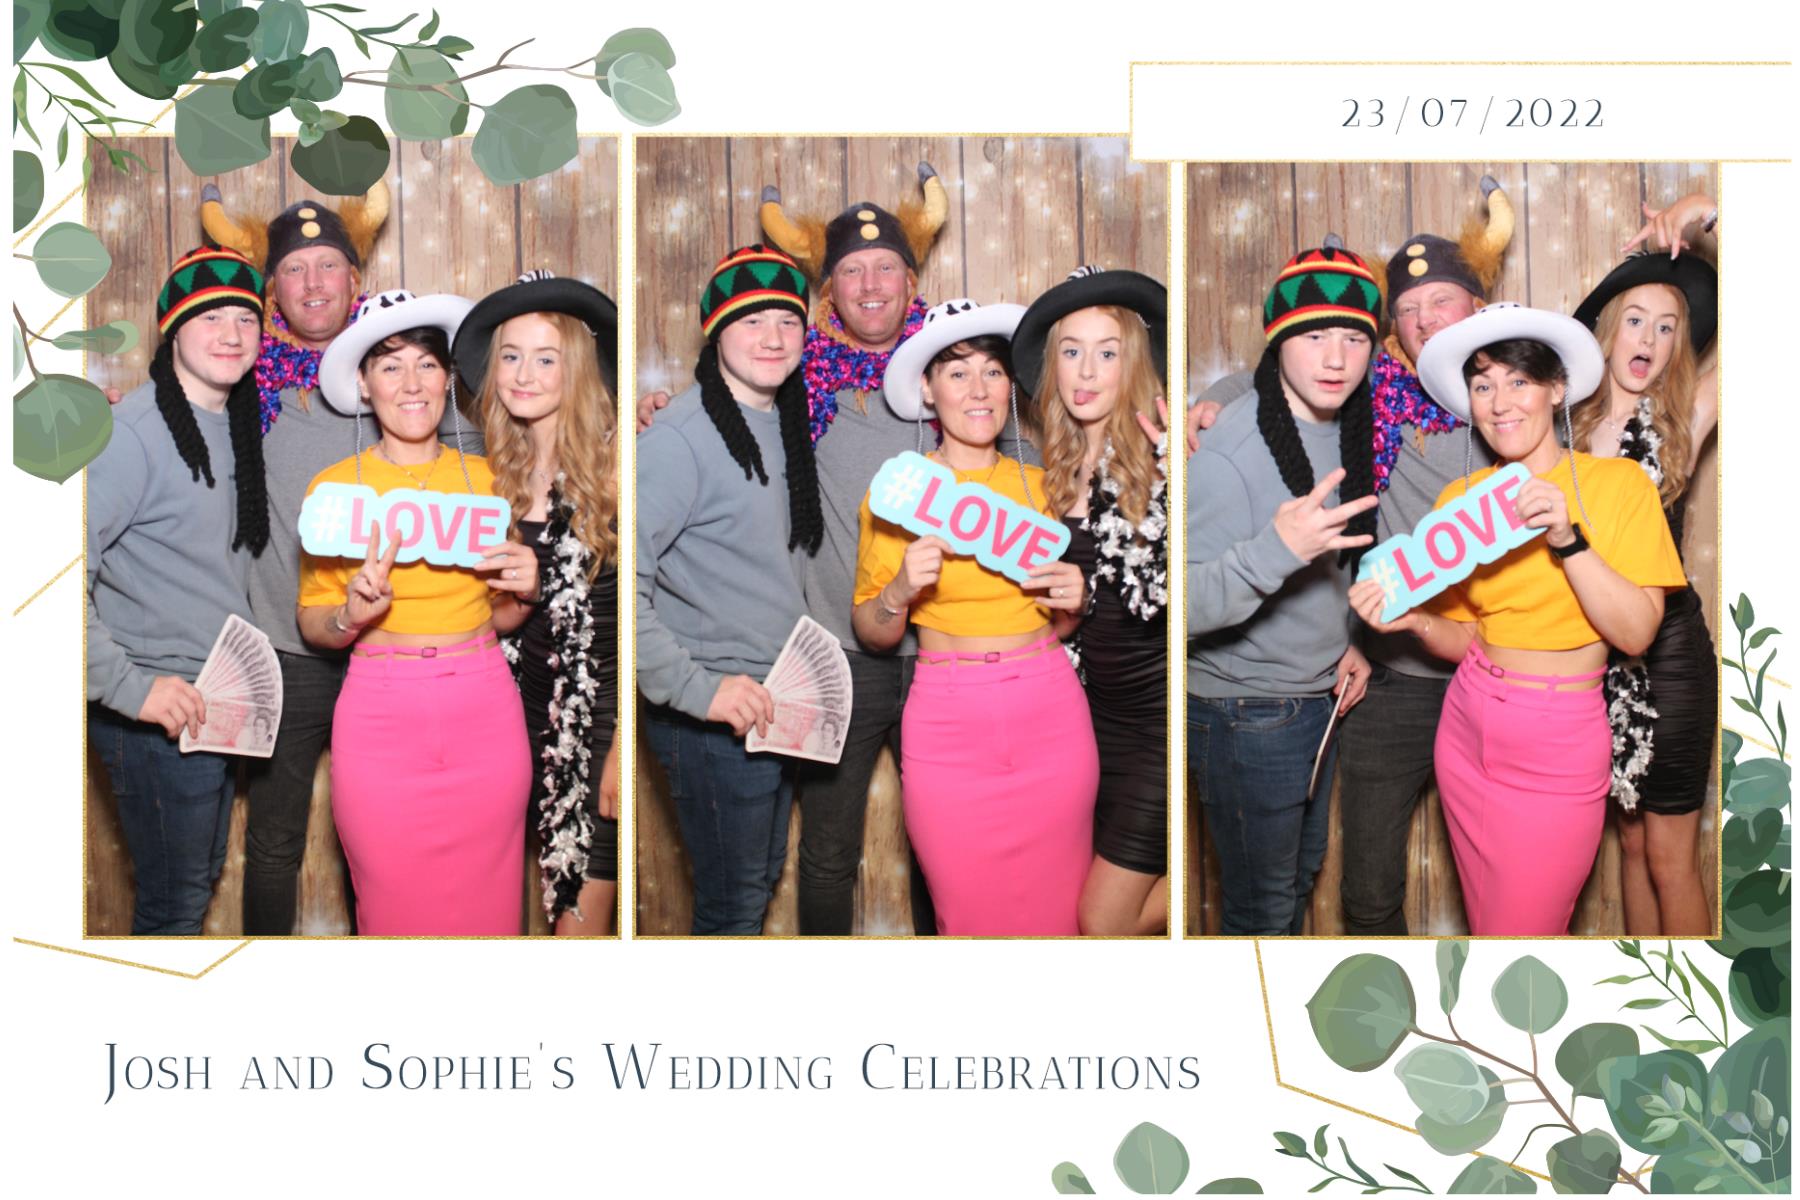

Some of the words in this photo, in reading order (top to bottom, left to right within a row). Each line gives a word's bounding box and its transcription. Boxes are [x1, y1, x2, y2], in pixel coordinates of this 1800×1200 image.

[311, 494, 501, 554] #LOVE
[882, 463, 1061, 572] #LOVE
[1370, 475, 1528, 608] #LOVE
